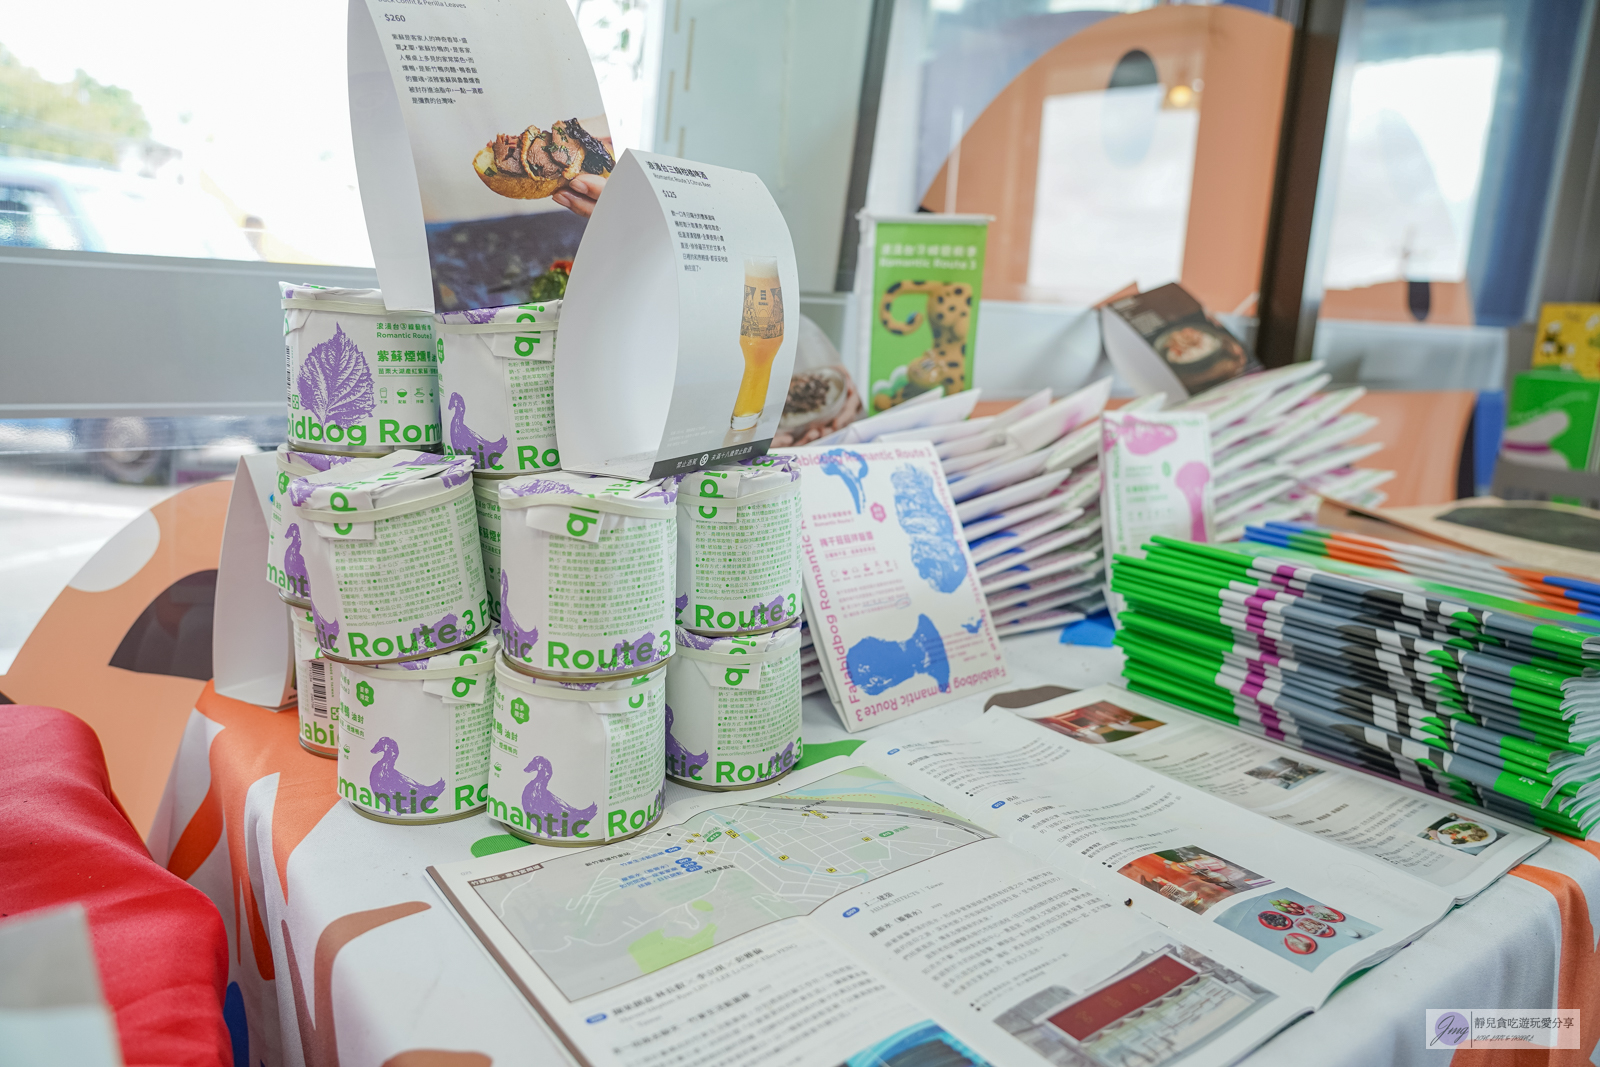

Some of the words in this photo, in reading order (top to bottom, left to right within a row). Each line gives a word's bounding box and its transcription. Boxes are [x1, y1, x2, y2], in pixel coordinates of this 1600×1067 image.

[384, 14, 406, 22] $260
[662, 190, 677, 198] $125
[676, 458, 697, 469] 禁止酒駕
[710, 446, 753, 462] 未滿十八歲禁止飲酒
[896, 448, 924, 459] Route
[801, 534, 831, 611] Romantic
[696, 602, 783, 629] Route
[787, 593, 796, 617] 3
[348, 623, 457, 657] Route
[462, 610, 476, 636] 3
[548, 640, 653, 670] Route
[660, 630, 671, 657] 3
[953, 665, 1006, 689] Falabidbog
[855, 708, 864, 722] 3
[864, 696, 898, 718] Route
[716, 748, 793, 783] Route
[795, 737, 802, 759] 3
[339, 776, 438, 814] mantic
[487, 794, 590, 838] mantic
